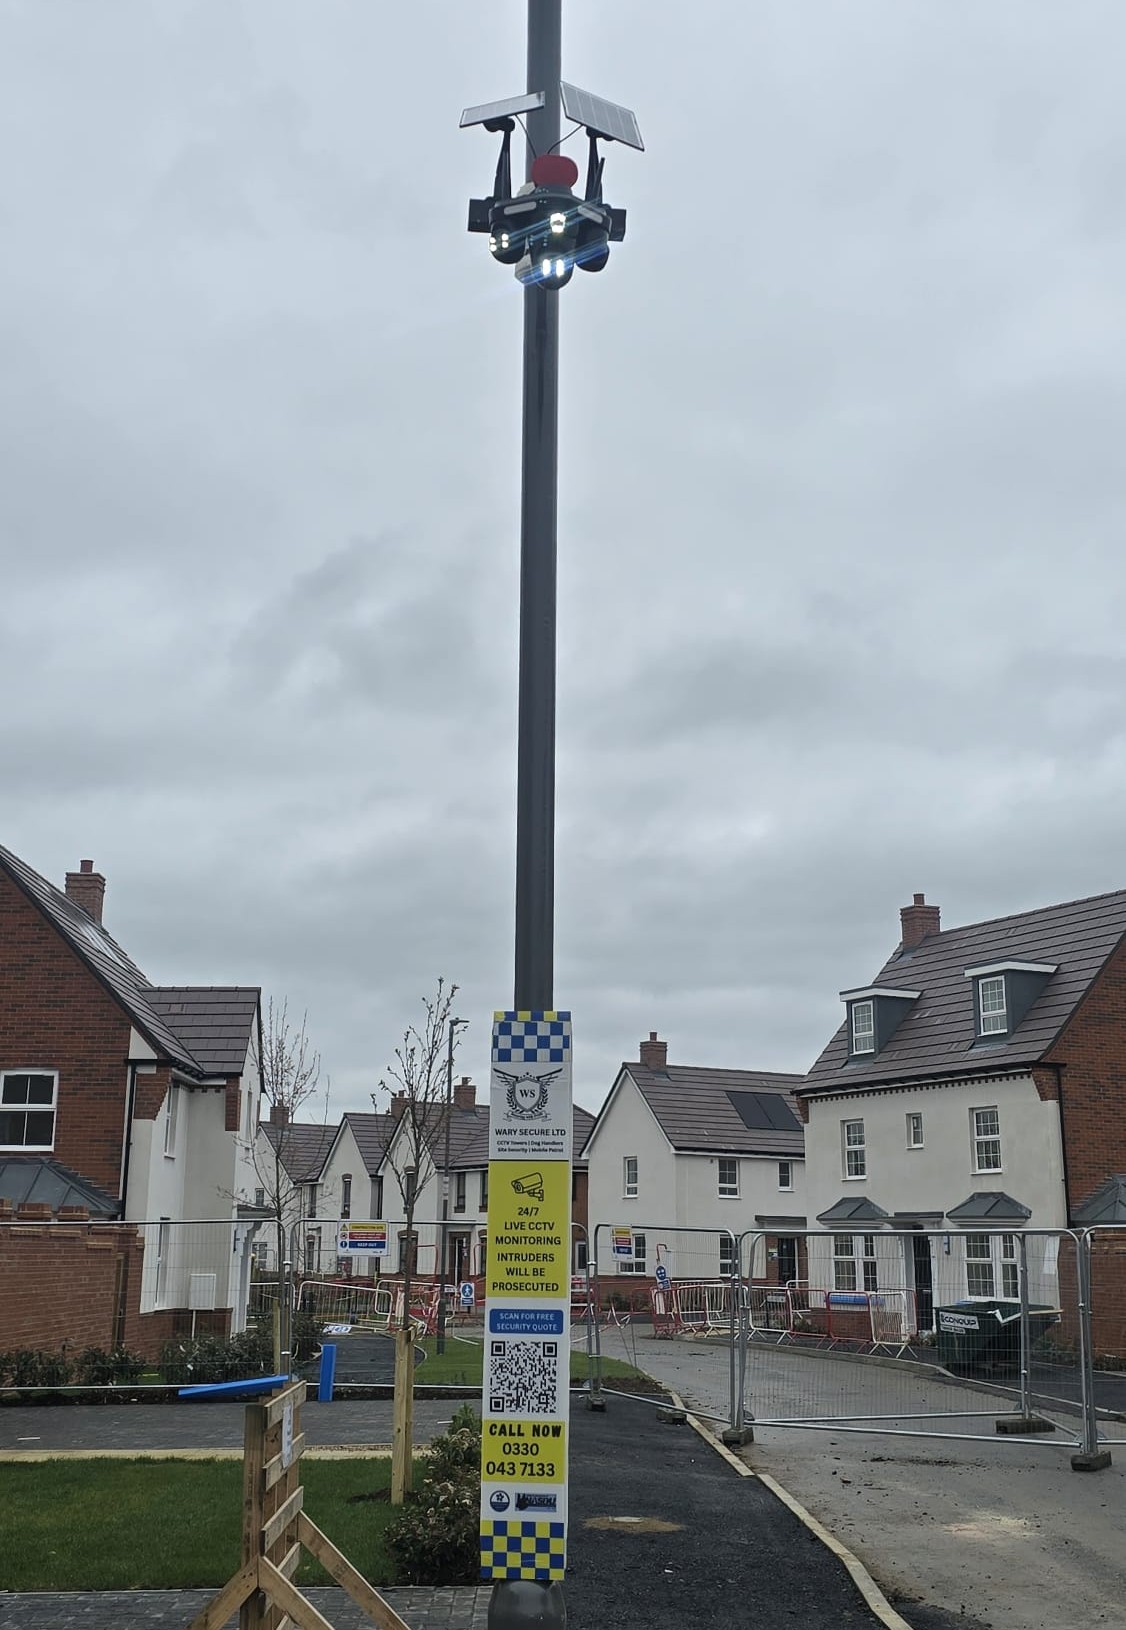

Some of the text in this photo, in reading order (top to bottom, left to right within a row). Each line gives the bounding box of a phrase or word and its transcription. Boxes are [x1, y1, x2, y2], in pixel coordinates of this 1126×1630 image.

[519, 1089, 536, 1098] WS
[495, 1128, 566, 1136] WARY SECURE LTD
[517, 1207, 540, 1217] 24/7
[504, 1221, 555, 1231] LIVE CCTV
[495, 1235, 562, 1245] MONITORING
[497, 1252, 555, 1262] INTRUDERS
[505, 1267, 546, 1277] WILL BE
[492, 1281, 560, 1292] PROSECUTED
[499, 1312, 520, 1320] SCAN
[536, 1313, 555, 1321] FREE
[496, 1322, 558, 1332] SECURITY QUOTE
[489, 1423, 562, 1438] CALL NOW
[502, 1442, 540, 1456] 0330
[486, 1461, 555, 1477] 043 7133
